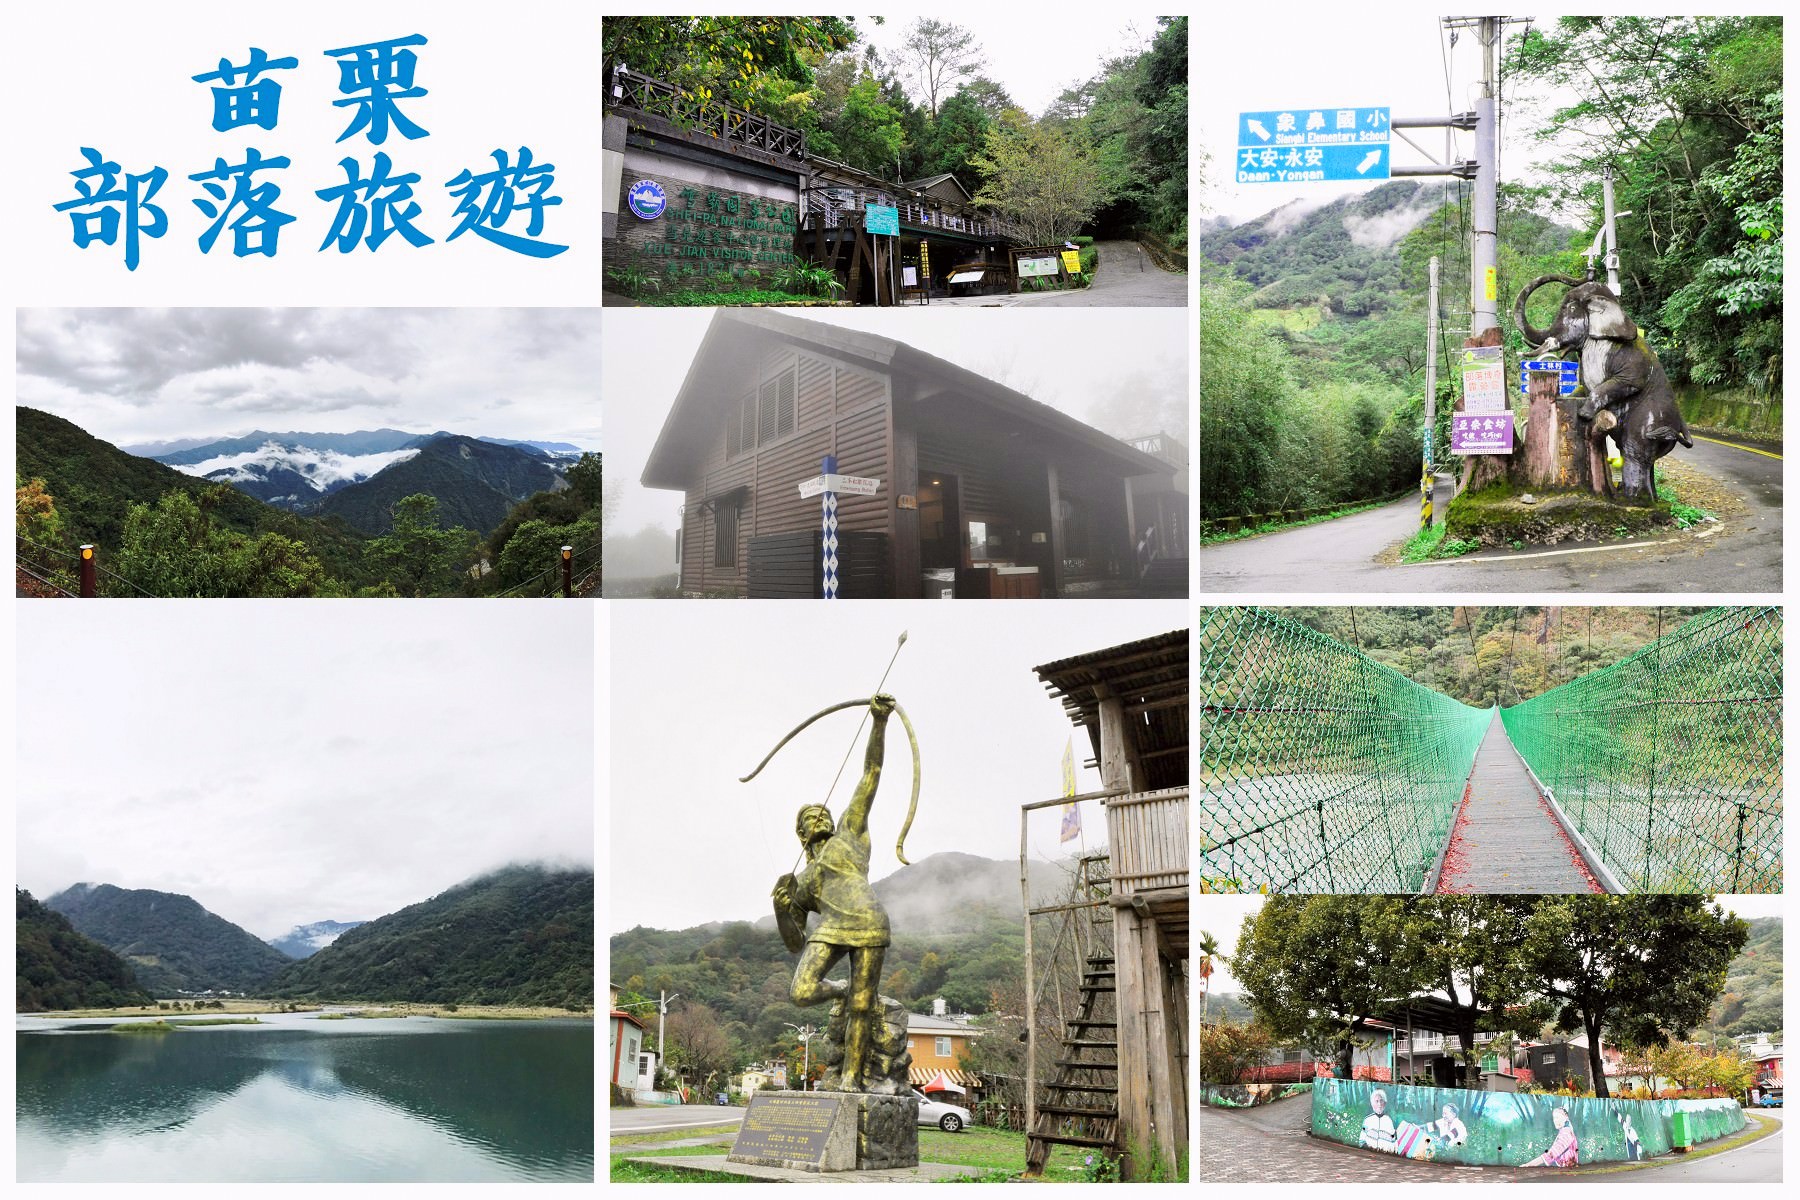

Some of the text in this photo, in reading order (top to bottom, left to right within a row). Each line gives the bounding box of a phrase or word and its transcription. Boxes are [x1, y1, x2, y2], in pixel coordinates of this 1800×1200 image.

[1276, 110, 1387, 132] 象鼻國小
[1307, 130, 1356, 144] Elementary
[1359, 130, 1388, 142] School
[666, 206, 717, 224] SHEI-PA
